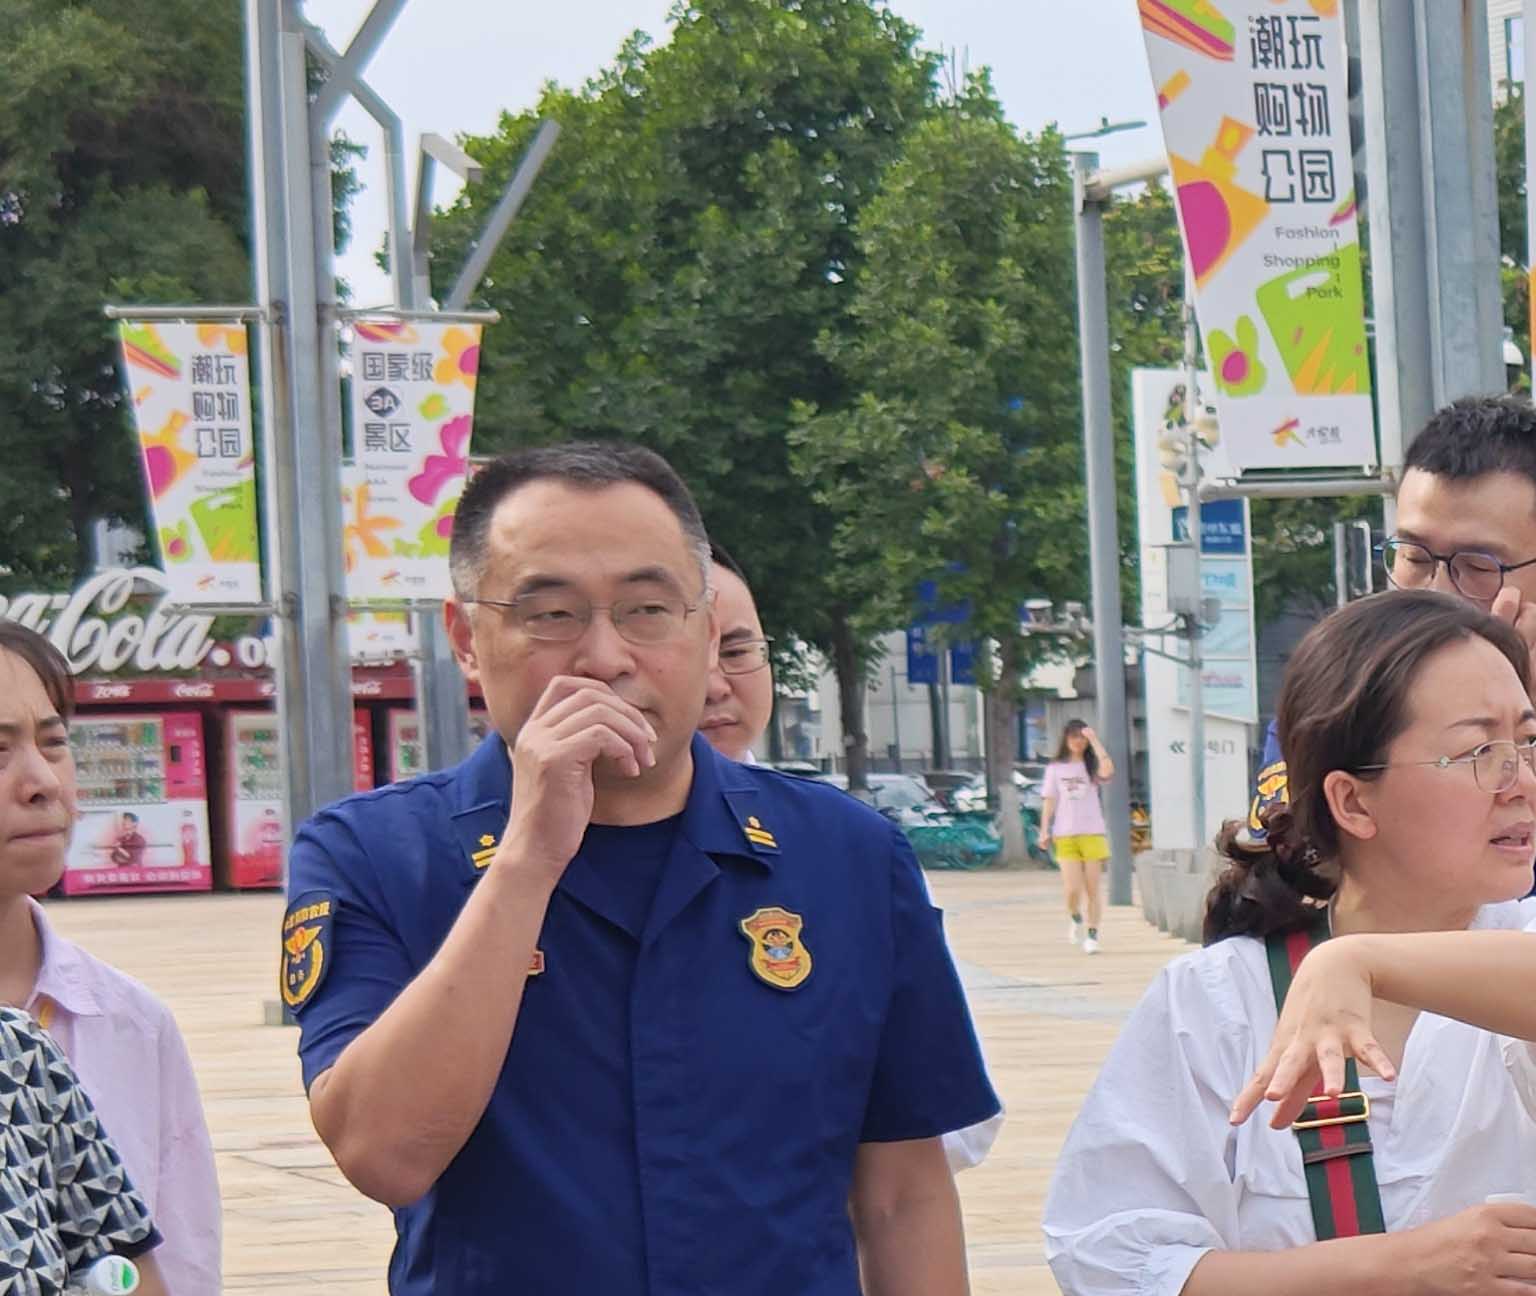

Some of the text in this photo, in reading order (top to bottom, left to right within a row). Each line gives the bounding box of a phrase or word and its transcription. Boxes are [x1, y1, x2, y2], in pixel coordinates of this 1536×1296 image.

[1250, 15, 1325, 70] 潮玩
[1255, 82, 1331, 137] 购物
[1264, 150, 1336, 203] 公园
[1275, 226, 1340, 239] Fashion
[1263, 253, 1340, 268] Shopping
[1306, 286, 1343, 298] Park
[191, 354, 237, 385] 潮玩
[362, 352, 433, 383] 国家级
[193, 392, 239, 422] 购物
[372, 394, 396, 412] 3A
[196, 429, 240, 458] 公园
[364, 422, 412, 453] 景区
[0, 567, 215, 675] a-Cola
